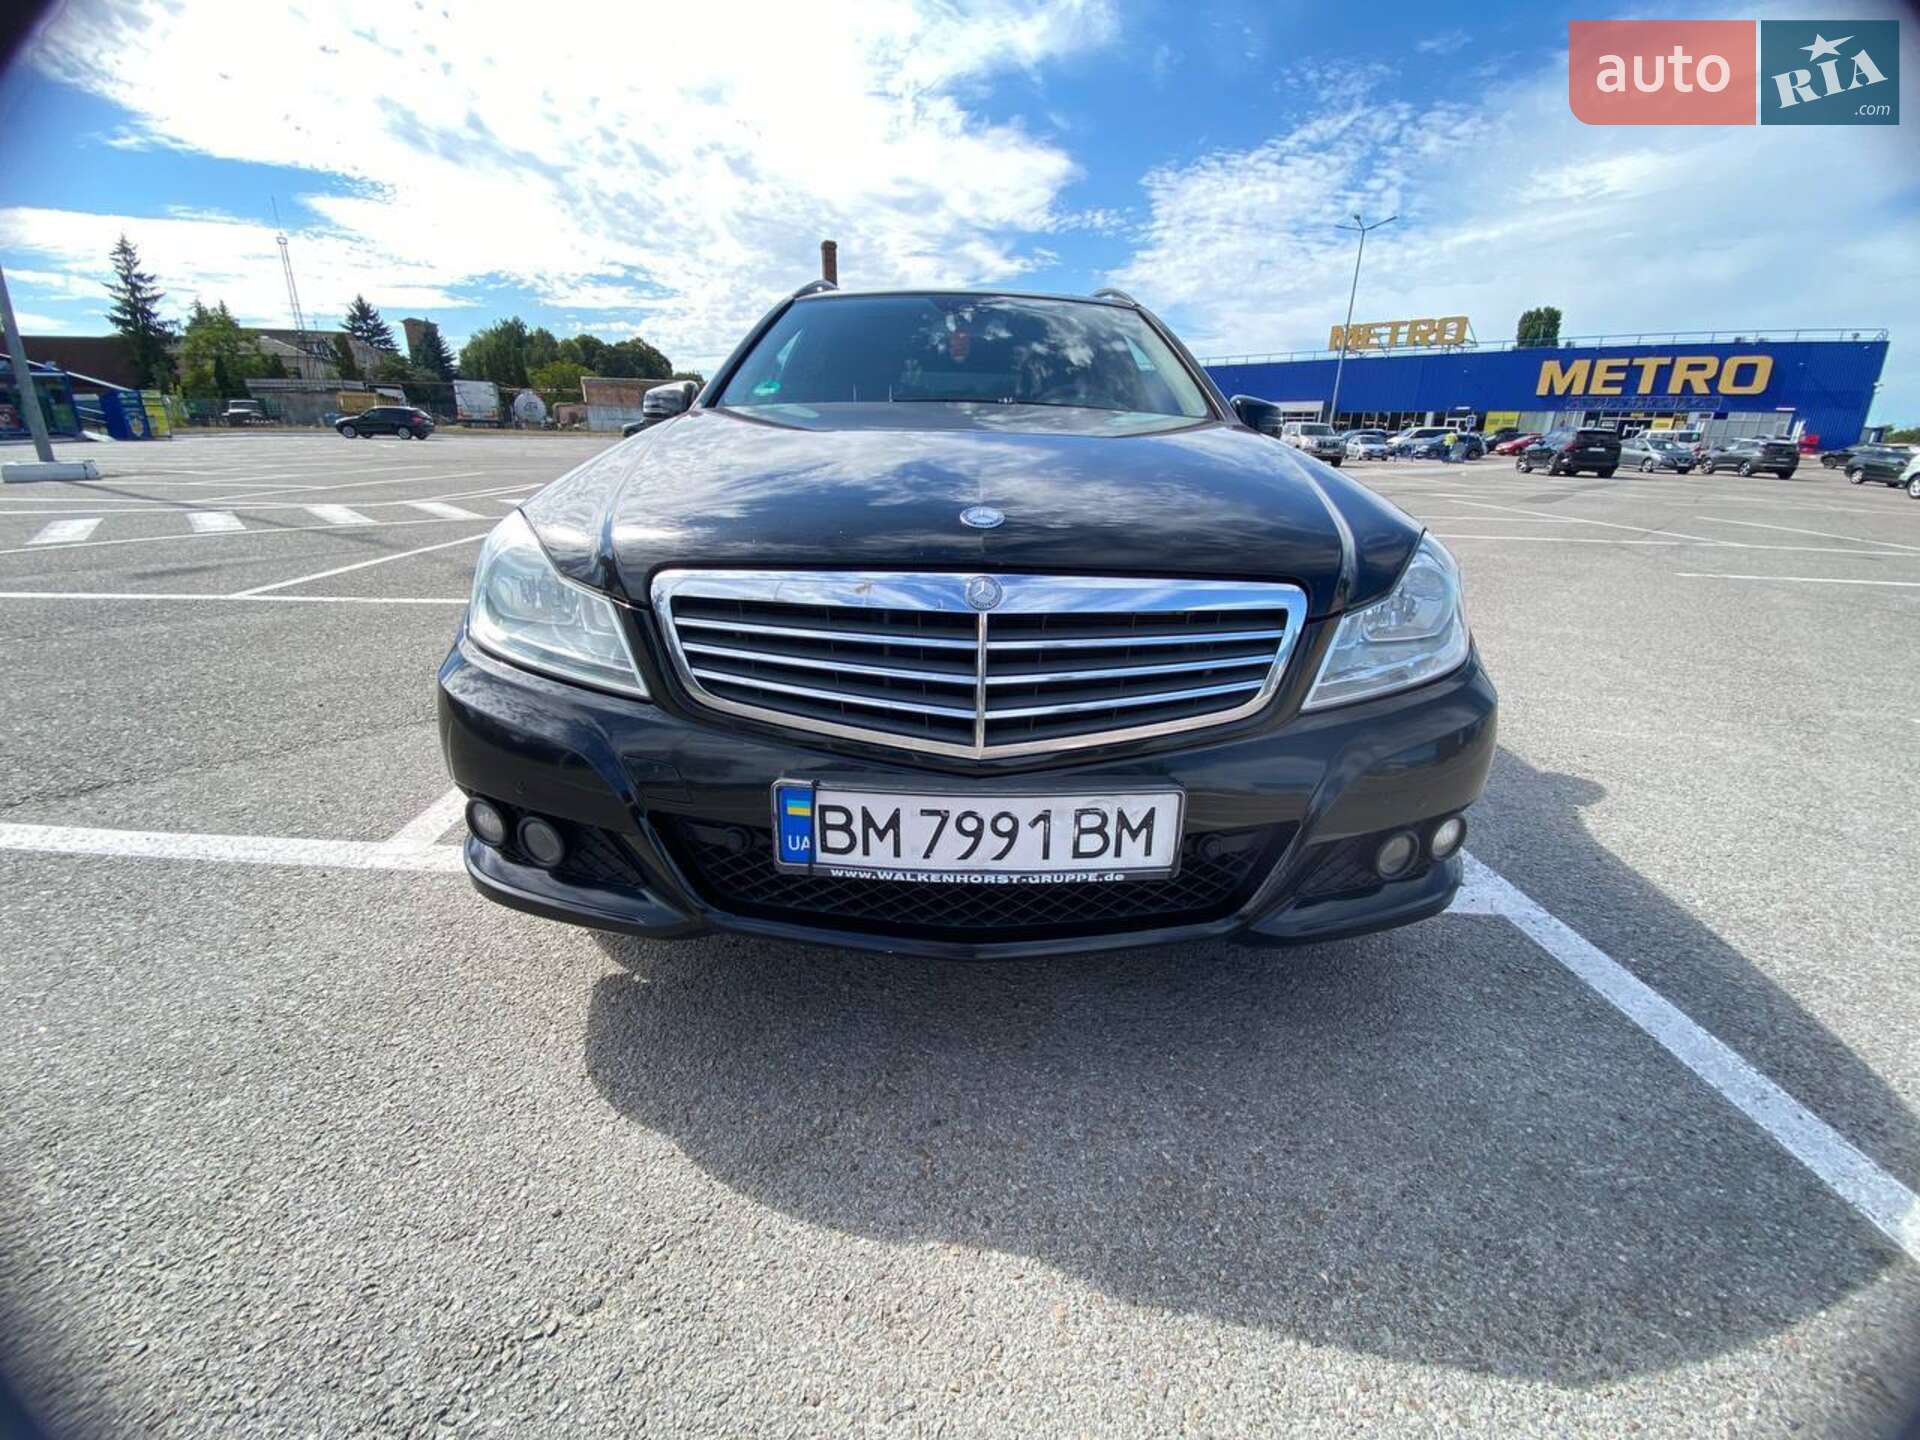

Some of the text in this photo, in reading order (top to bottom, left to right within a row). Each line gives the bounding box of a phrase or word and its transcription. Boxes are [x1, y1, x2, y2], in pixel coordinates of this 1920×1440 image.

[1329, 316, 1468, 351] METRO
[1535, 355, 1774, 396] METRO
[787, 834, 811, 852] UA
[818, 804, 1156, 861] BM 7991 BM
